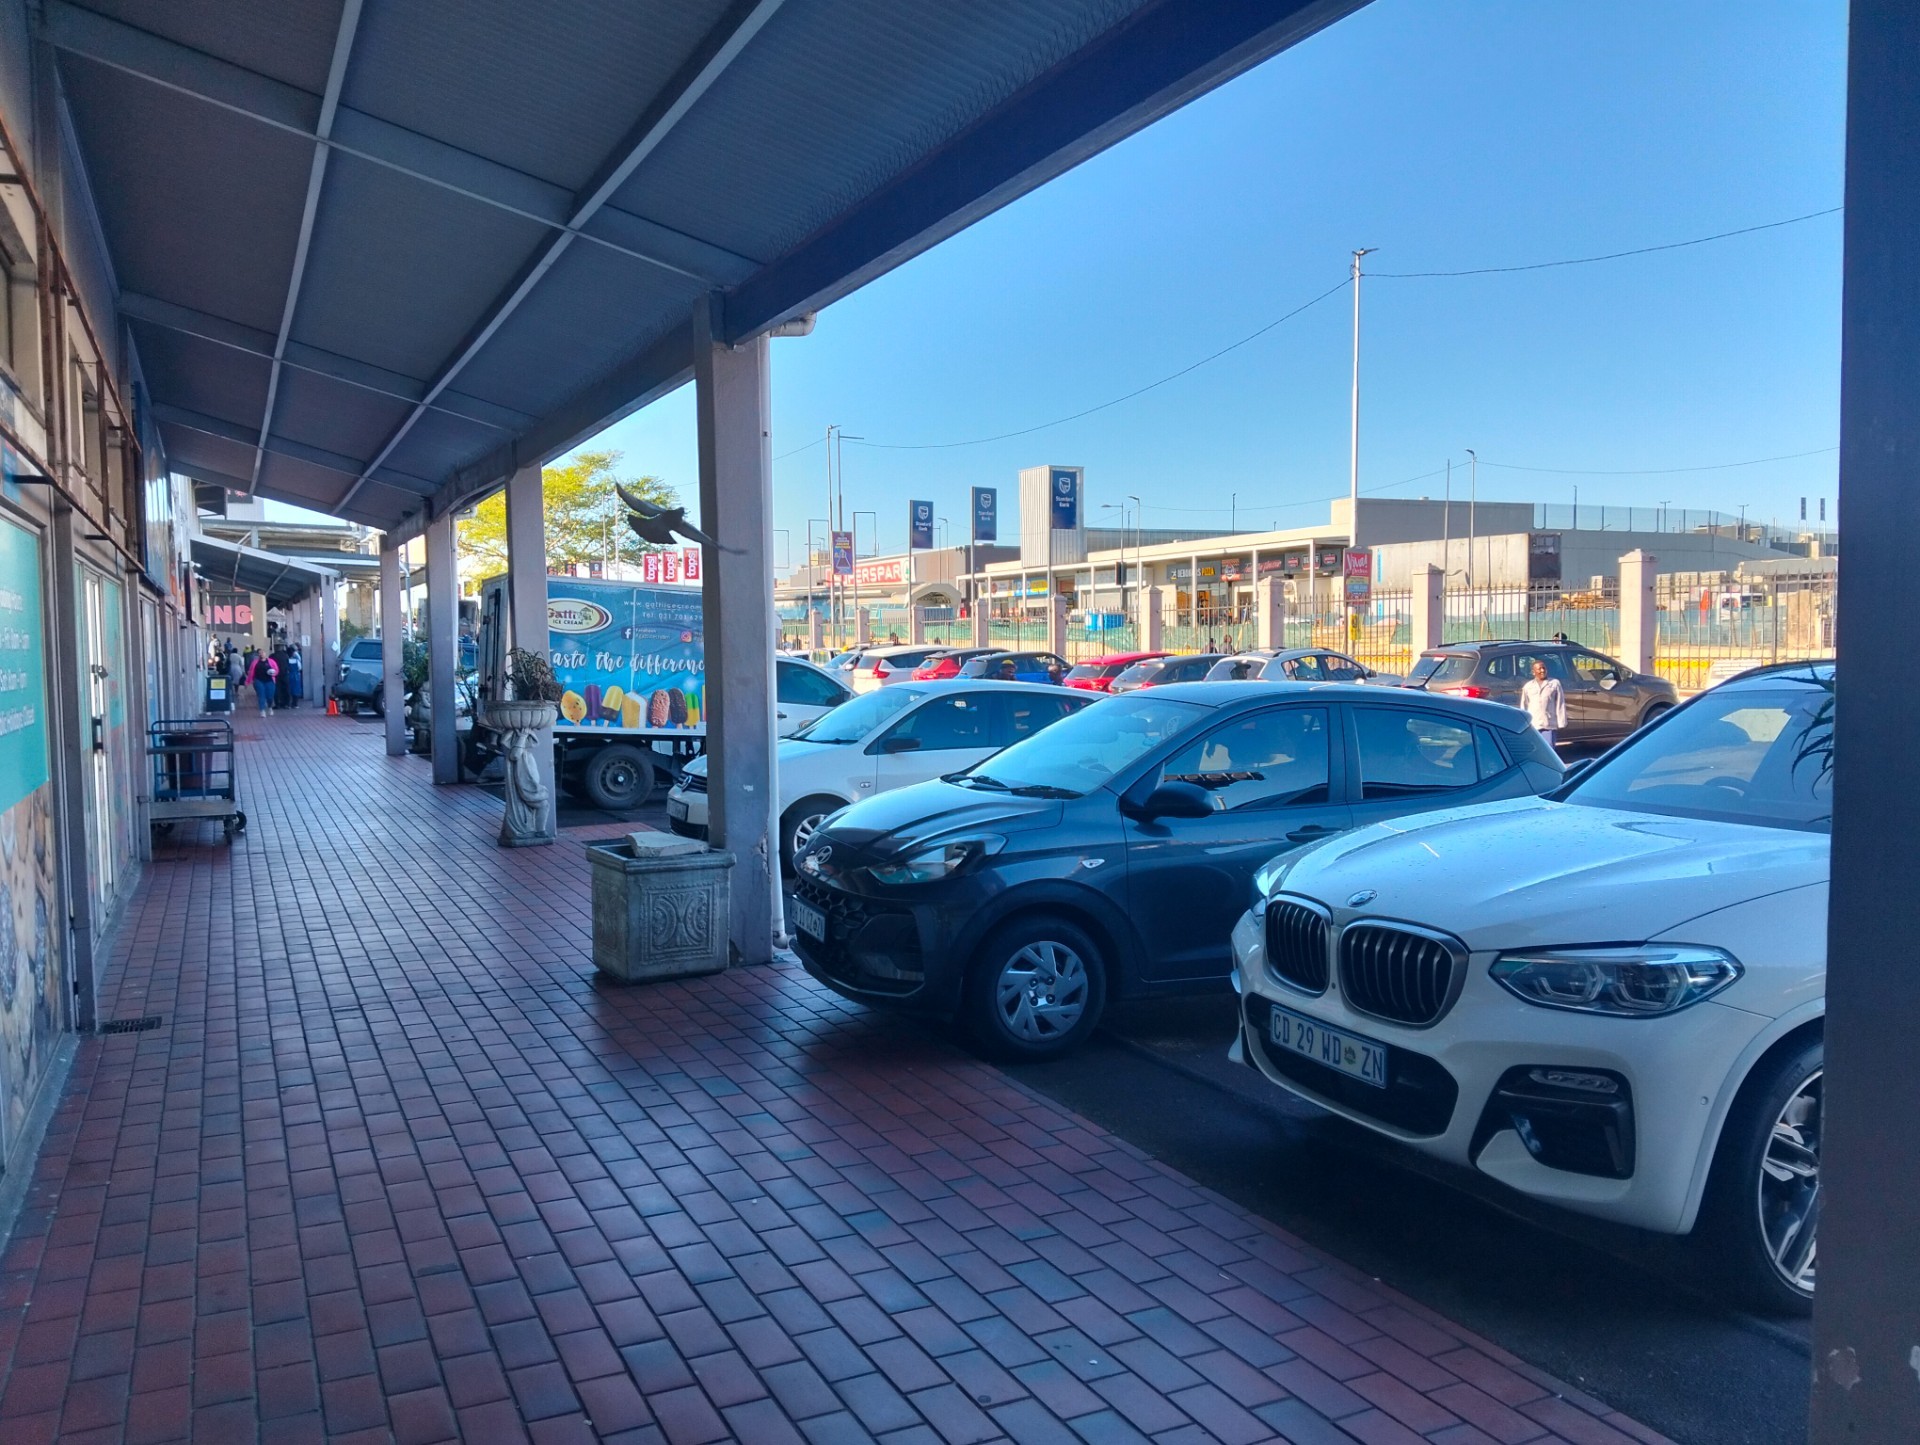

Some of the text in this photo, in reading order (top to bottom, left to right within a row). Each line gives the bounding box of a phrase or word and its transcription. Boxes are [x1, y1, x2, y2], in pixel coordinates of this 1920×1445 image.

[549, 649, 587, 669] aste
[596, 651, 625, 672] the
[1273, 1013, 1291, 1044] CD
[1296, 1022, 1315, 1054] 29
[1361, 1046, 1384, 1083] ZN
